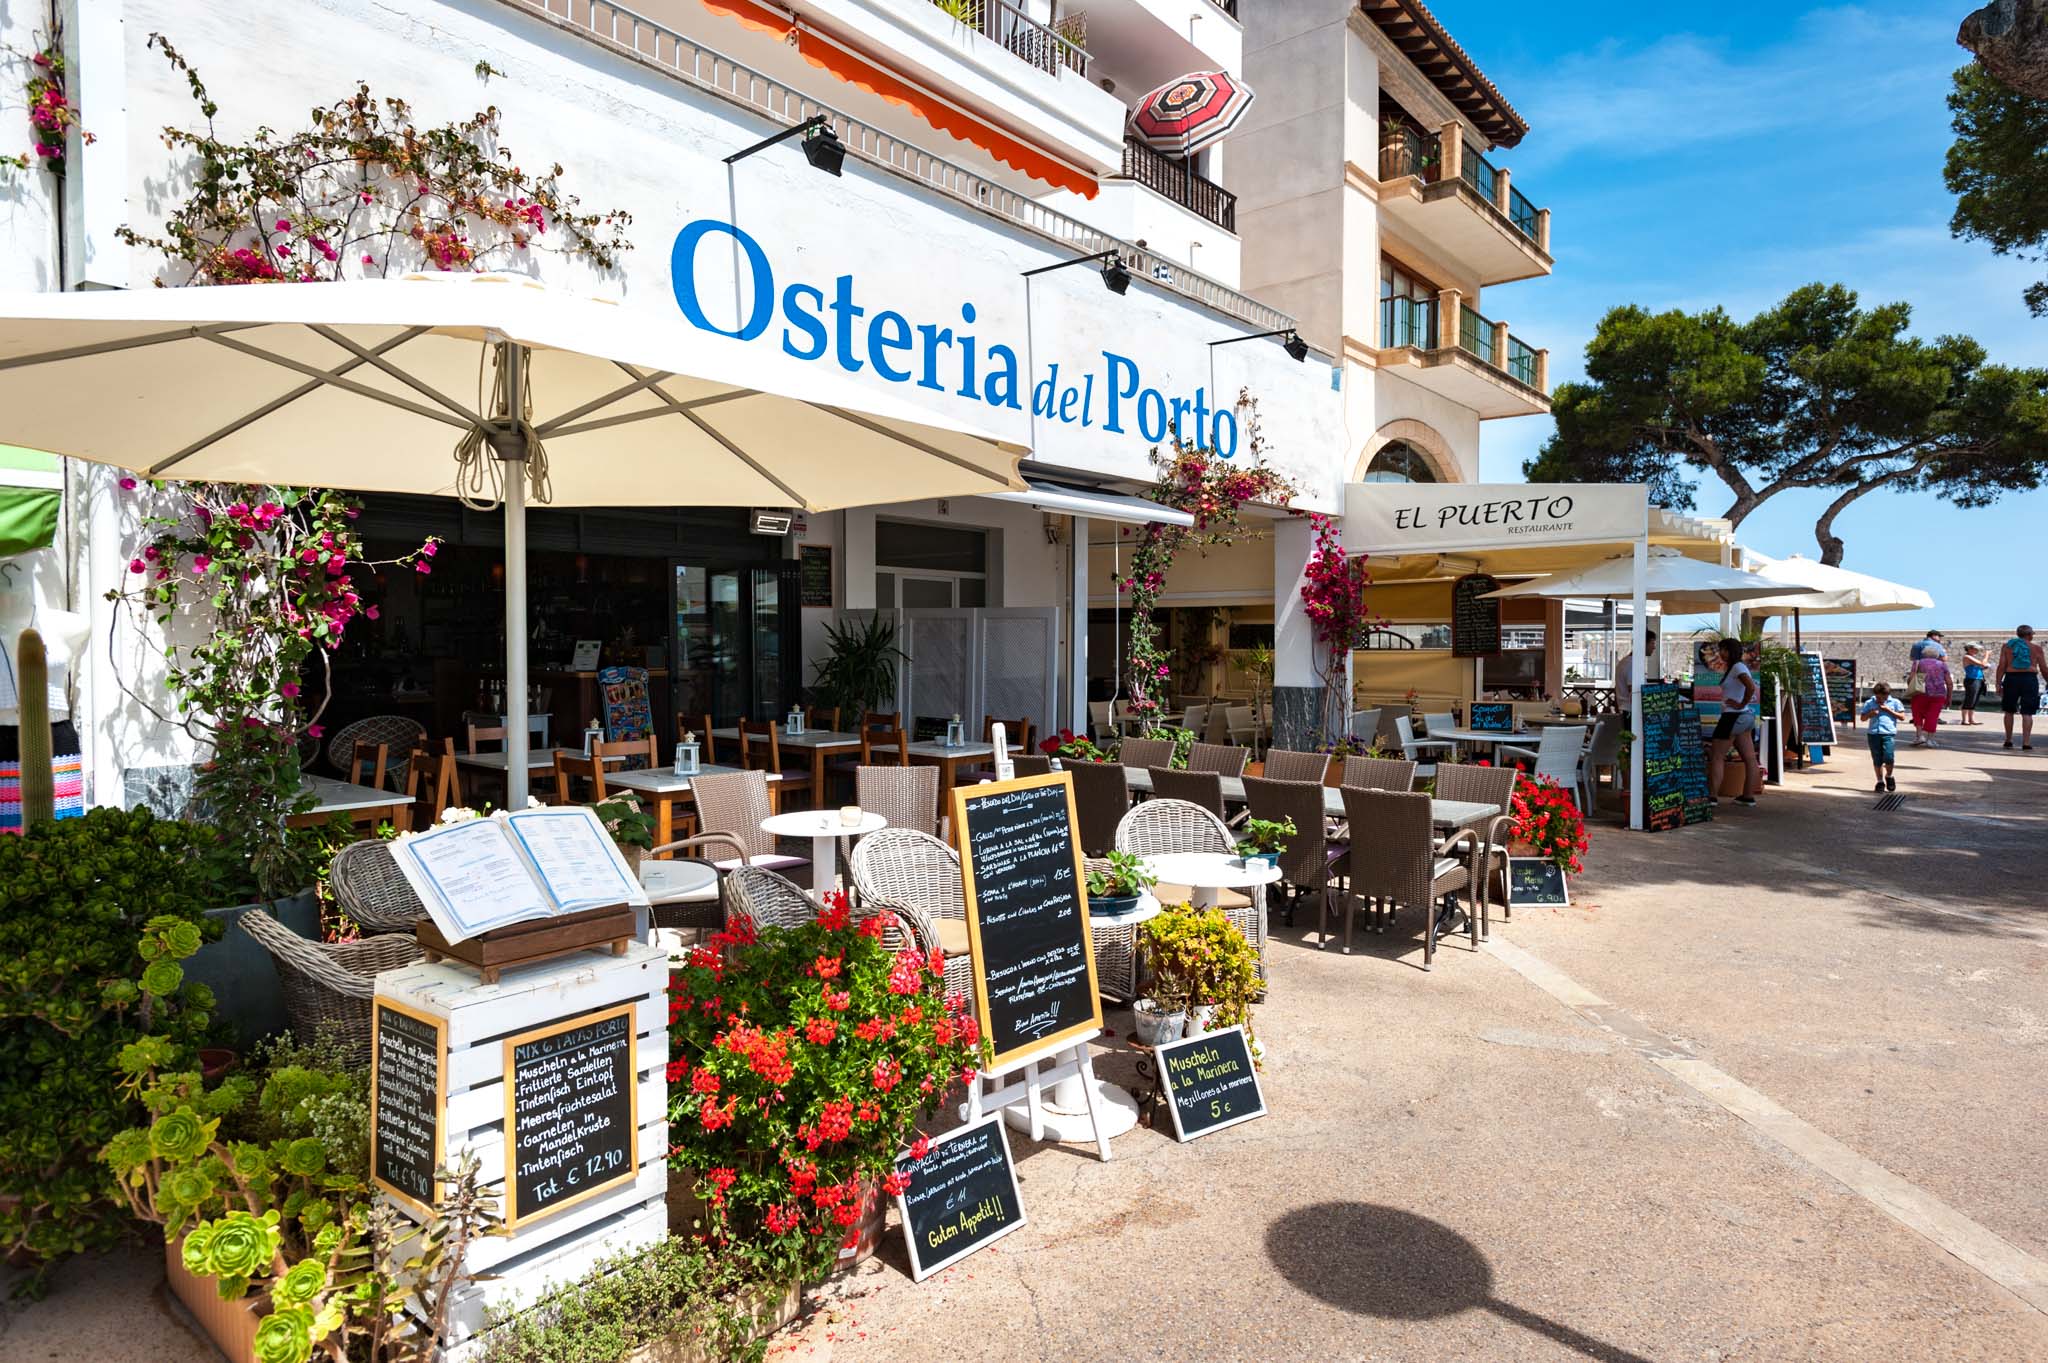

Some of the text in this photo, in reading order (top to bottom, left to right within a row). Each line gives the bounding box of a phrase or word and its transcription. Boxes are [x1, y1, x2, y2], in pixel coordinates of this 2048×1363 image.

[671, 219, 1238, 459] Osteria del Porto
[1395, 496, 1574, 529] EL PUERTO
[1508, 523, 1574, 535] RESTAURANTE
[515, 1043, 540, 1060] MIX
[519, 1056, 568, 1081] Muscheln
[577, 1051, 587, 1061] la
[1169, 1046, 1220, 1073] Muscheln
[519, 1065, 614, 1112] Tintenfisch Eintopf
[520, 1056, 613, 1096] Frittierte Sardellen
[1171, 1059, 1239, 1092] a la Marinera
[521, 1082, 618, 1130] Meeresfrüchtesalat
[1177, 1088, 1216, 1108] Mejillones
[1219, 1081, 1228, 1091] la
[1210, 1100, 1231, 1119] 5 €
[523, 1119, 574, 1147] Garnelen
[522, 1142, 584, 1176] Tintenfisch
[566, 1167, 580, 1185] €
[928, 1194, 1006, 1248] Guten Appetit!!
